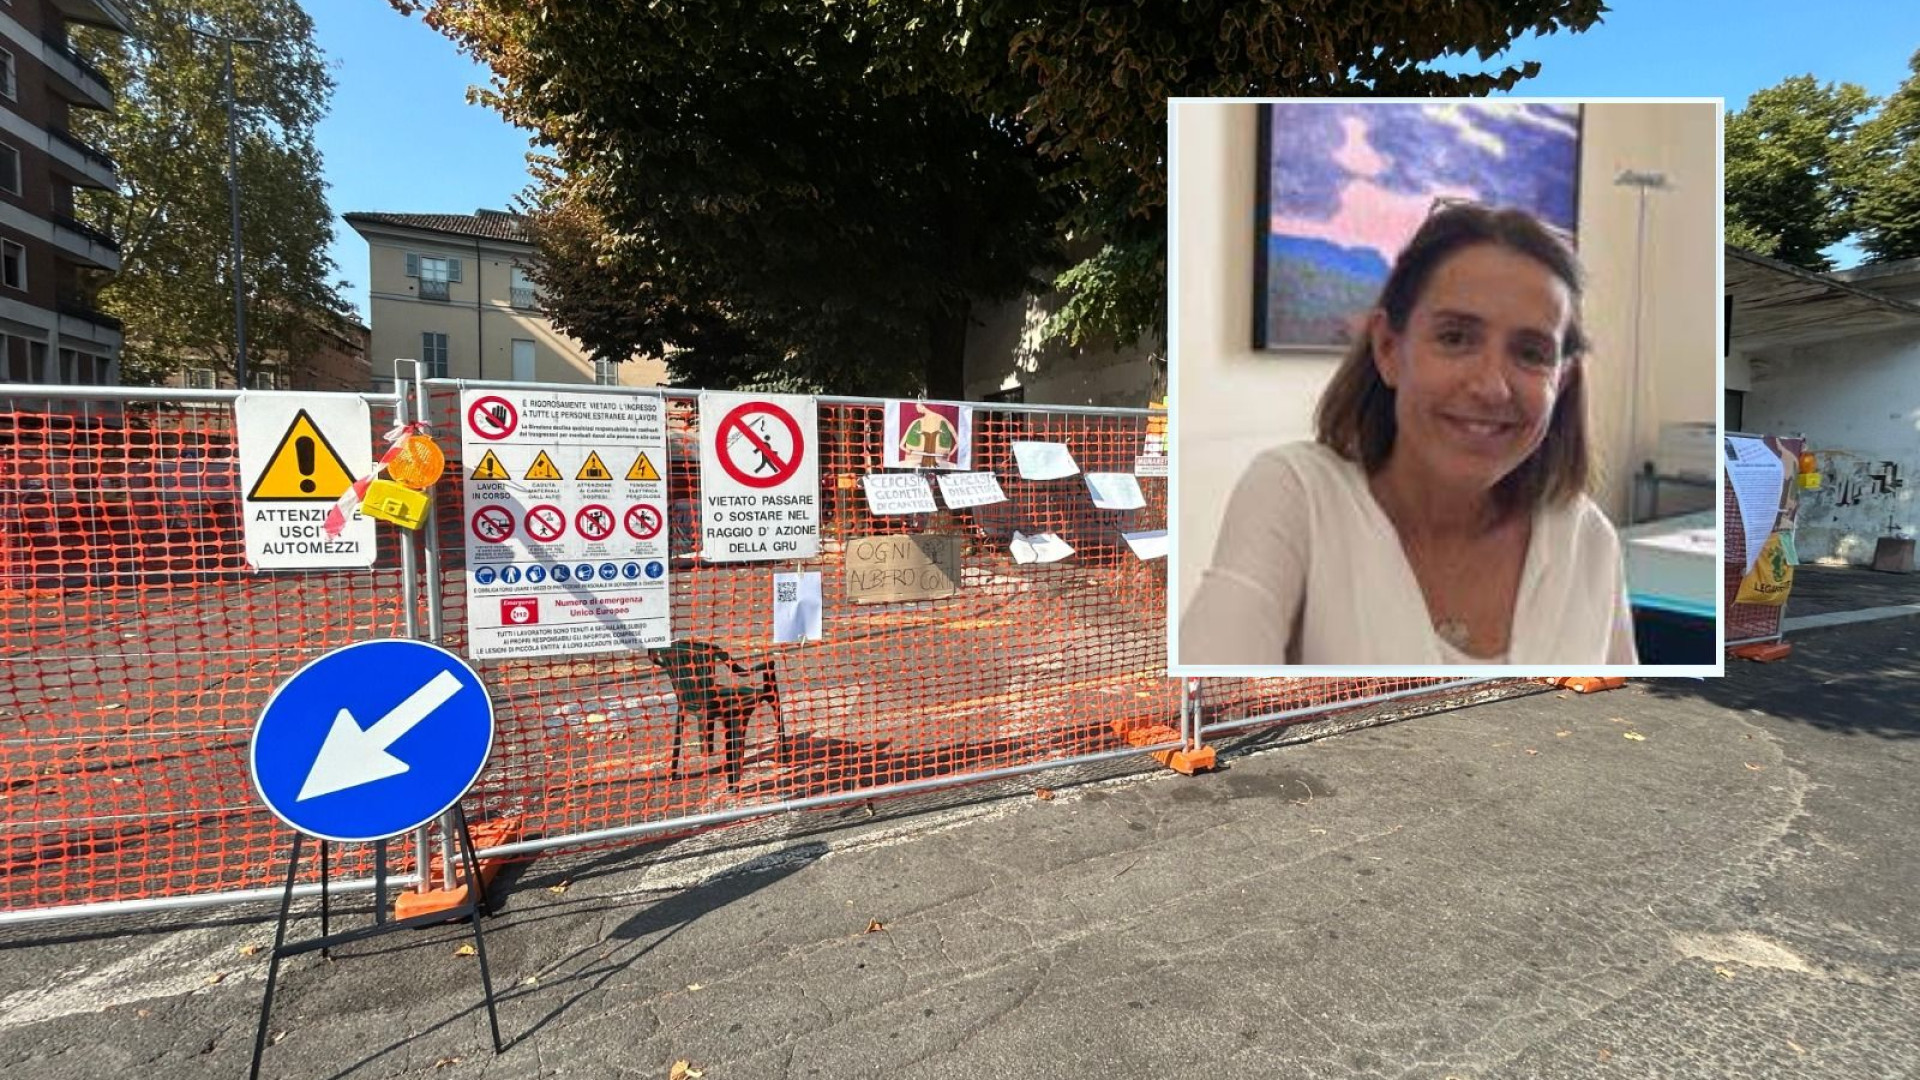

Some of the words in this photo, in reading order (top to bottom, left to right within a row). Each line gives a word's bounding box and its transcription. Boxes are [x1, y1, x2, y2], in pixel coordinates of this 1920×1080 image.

[530, 400, 587, 409] RIGOROSAMENTE
[590, 402, 617, 410] VIETATO
[619, 402, 657, 412] L'INGRESSO
[522, 410, 528, 418] A
[529, 409, 550, 418] TUTTE
[551, 411, 559, 419] LE
[561, 411, 592, 420] PERSONE
[593, 412, 625, 420] ESTRANEE
[635, 413, 657, 421] LAVORI
[477, 483, 505, 491] LAVORI
[708, 496, 757, 506] VIETATO
[762, 495, 813, 506] PASSARE
[256, 509, 362, 521] ATTENZIE
[714, 512, 723, 522] O
[729, 511, 783, 521] SOSTARE
[788, 510, 809, 520] NEL
[707, 527, 753, 538] RAGGIO
[758, 527, 769, 536] D'
[775, 525, 816, 535] AZIONE
[263, 541, 359, 554] AUTOMEZZI
[729, 543, 767, 553] DELLA
[773, 541, 797, 551] GRU
[857, 542, 911, 564] OGNI
[850, 568, 915, 592] ALBERO
[555, 599, 587, 607] Numero
[590, 596, 597, 605] di
[600, 596, 643, 606] emergenza
[596, 608, 629, 616] Europeo
[532, 635, 571, 643] RESPONSABILI
